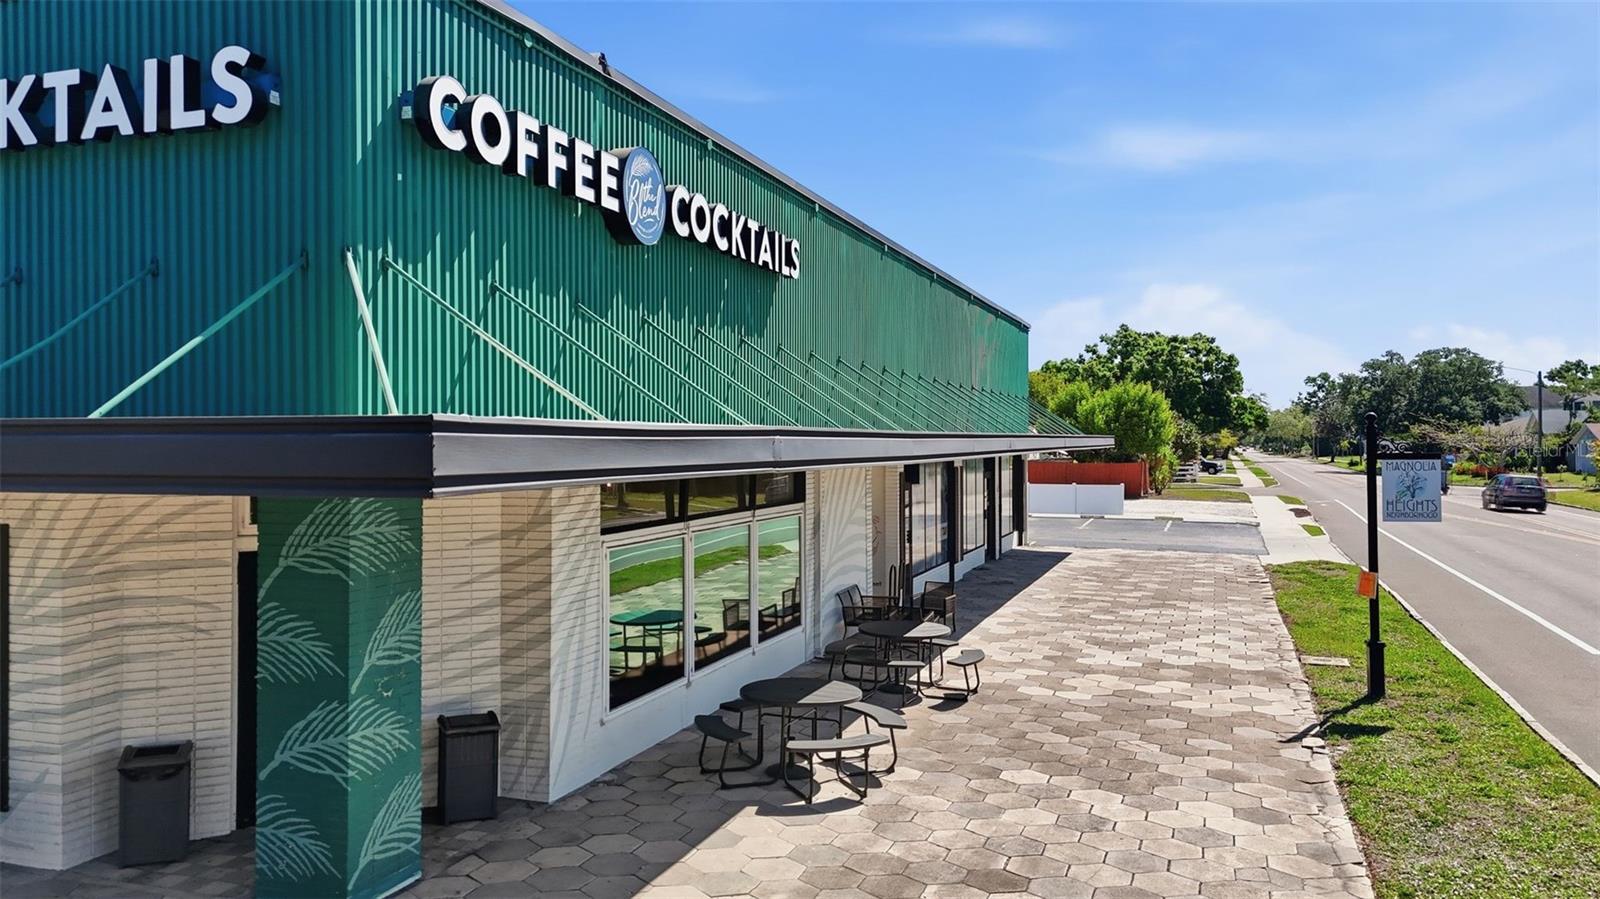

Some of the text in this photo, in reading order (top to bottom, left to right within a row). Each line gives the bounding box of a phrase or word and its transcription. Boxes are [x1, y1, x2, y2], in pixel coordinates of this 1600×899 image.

[428, 75, 620, 213] COFFEE
[628, 179, 662, 225] Blend
[643, 177, 657, 202] the
[671, 184, 800, 280] COCKTAILS
[1385, 461, 1437, 473] MAGNOLIA
[1386, 499, 1438, 512] HEIGHTS
